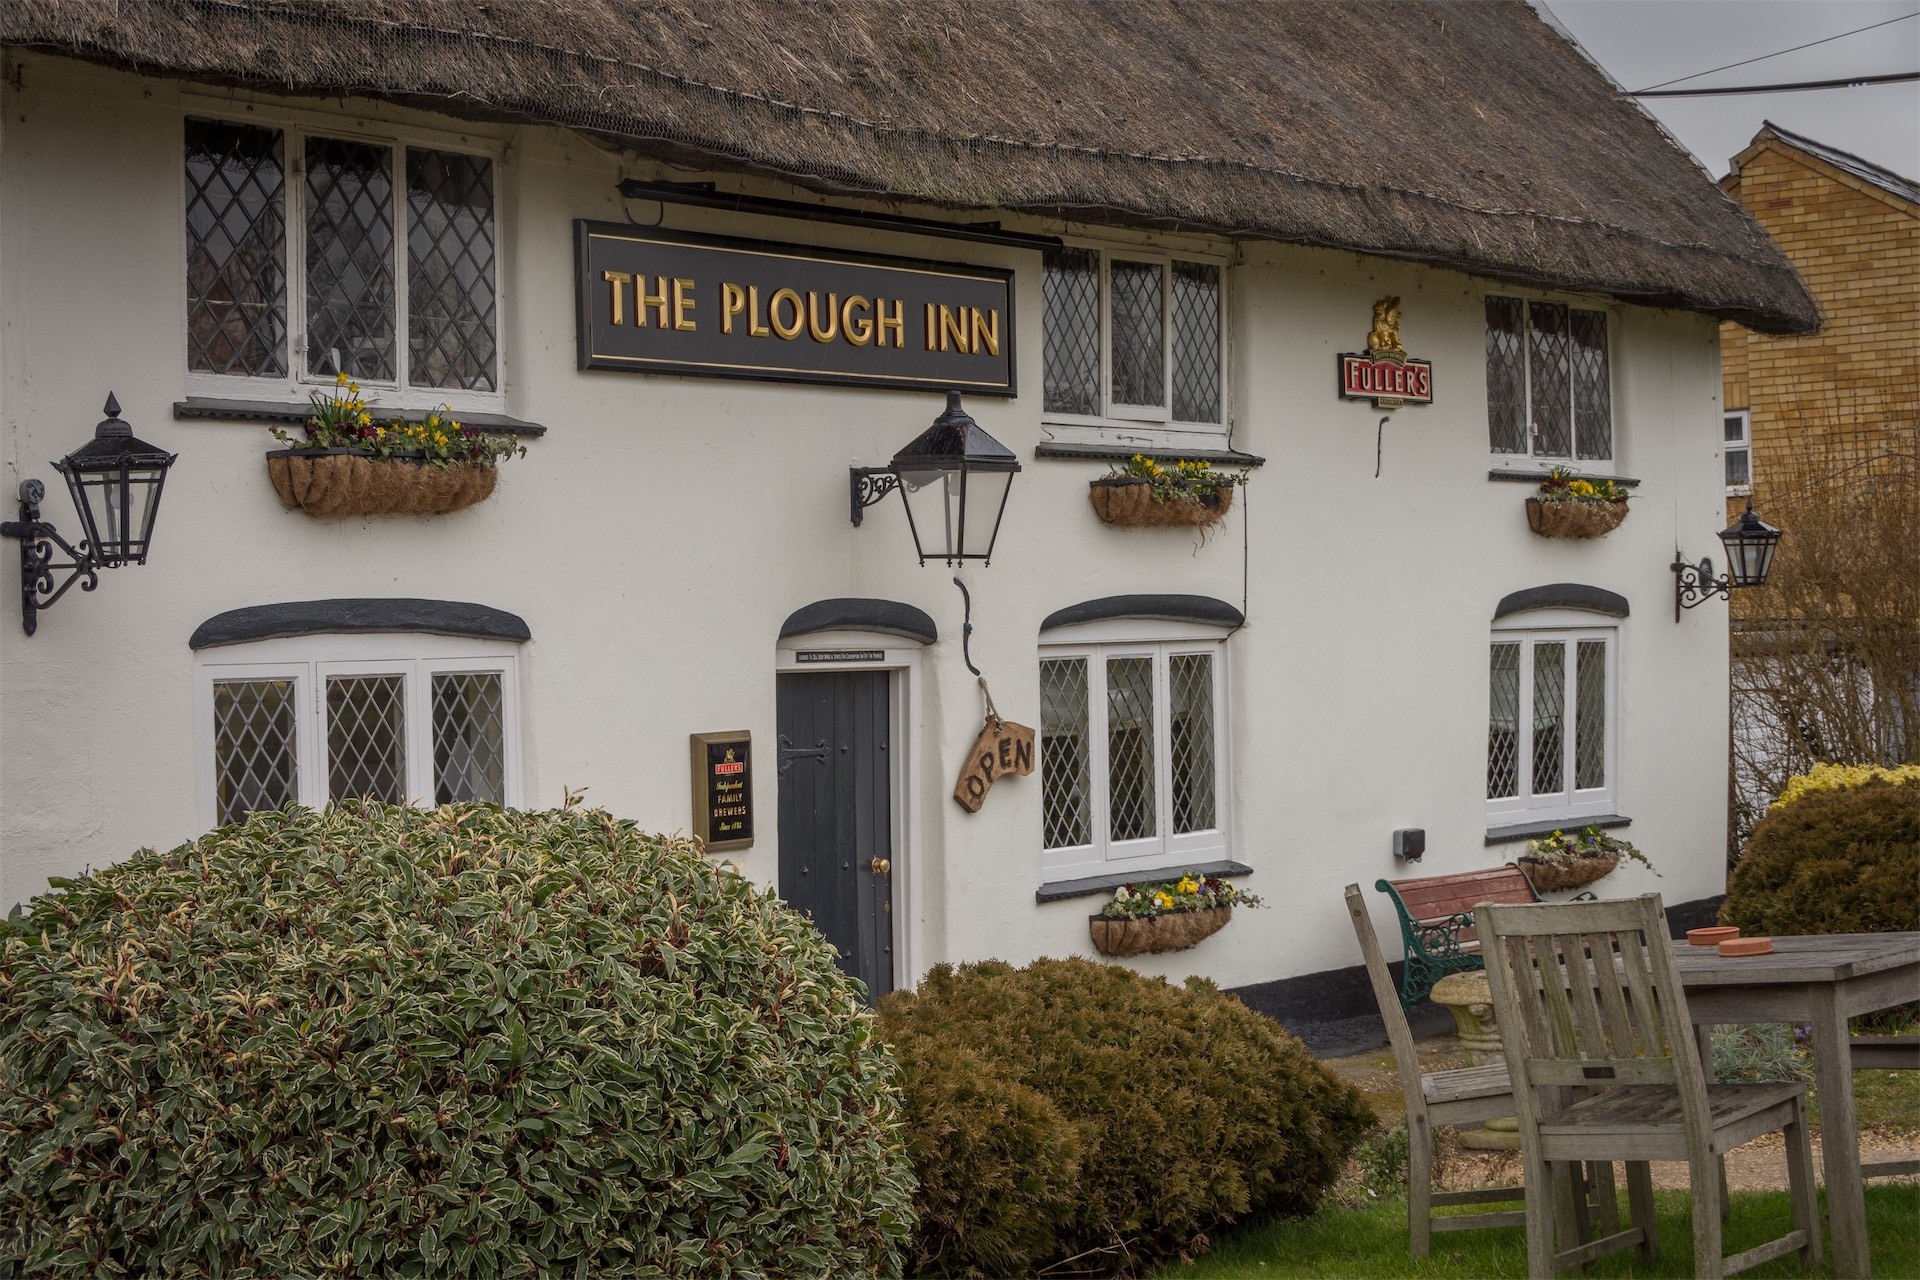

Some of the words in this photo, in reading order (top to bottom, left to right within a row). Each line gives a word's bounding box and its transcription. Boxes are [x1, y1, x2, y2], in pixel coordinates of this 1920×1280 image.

[602, 270, 697, 331] THE
[720, 282, 904, 348] PLOUGH
[924, 302, 998, 356] INN
[1350, 361, 1428, 396] FULLER'S
[965, 737, 1031, 799] OPEN
[714, 806, 746, 817] BREWERS
[718, 794, 742, 804] FAMILY
